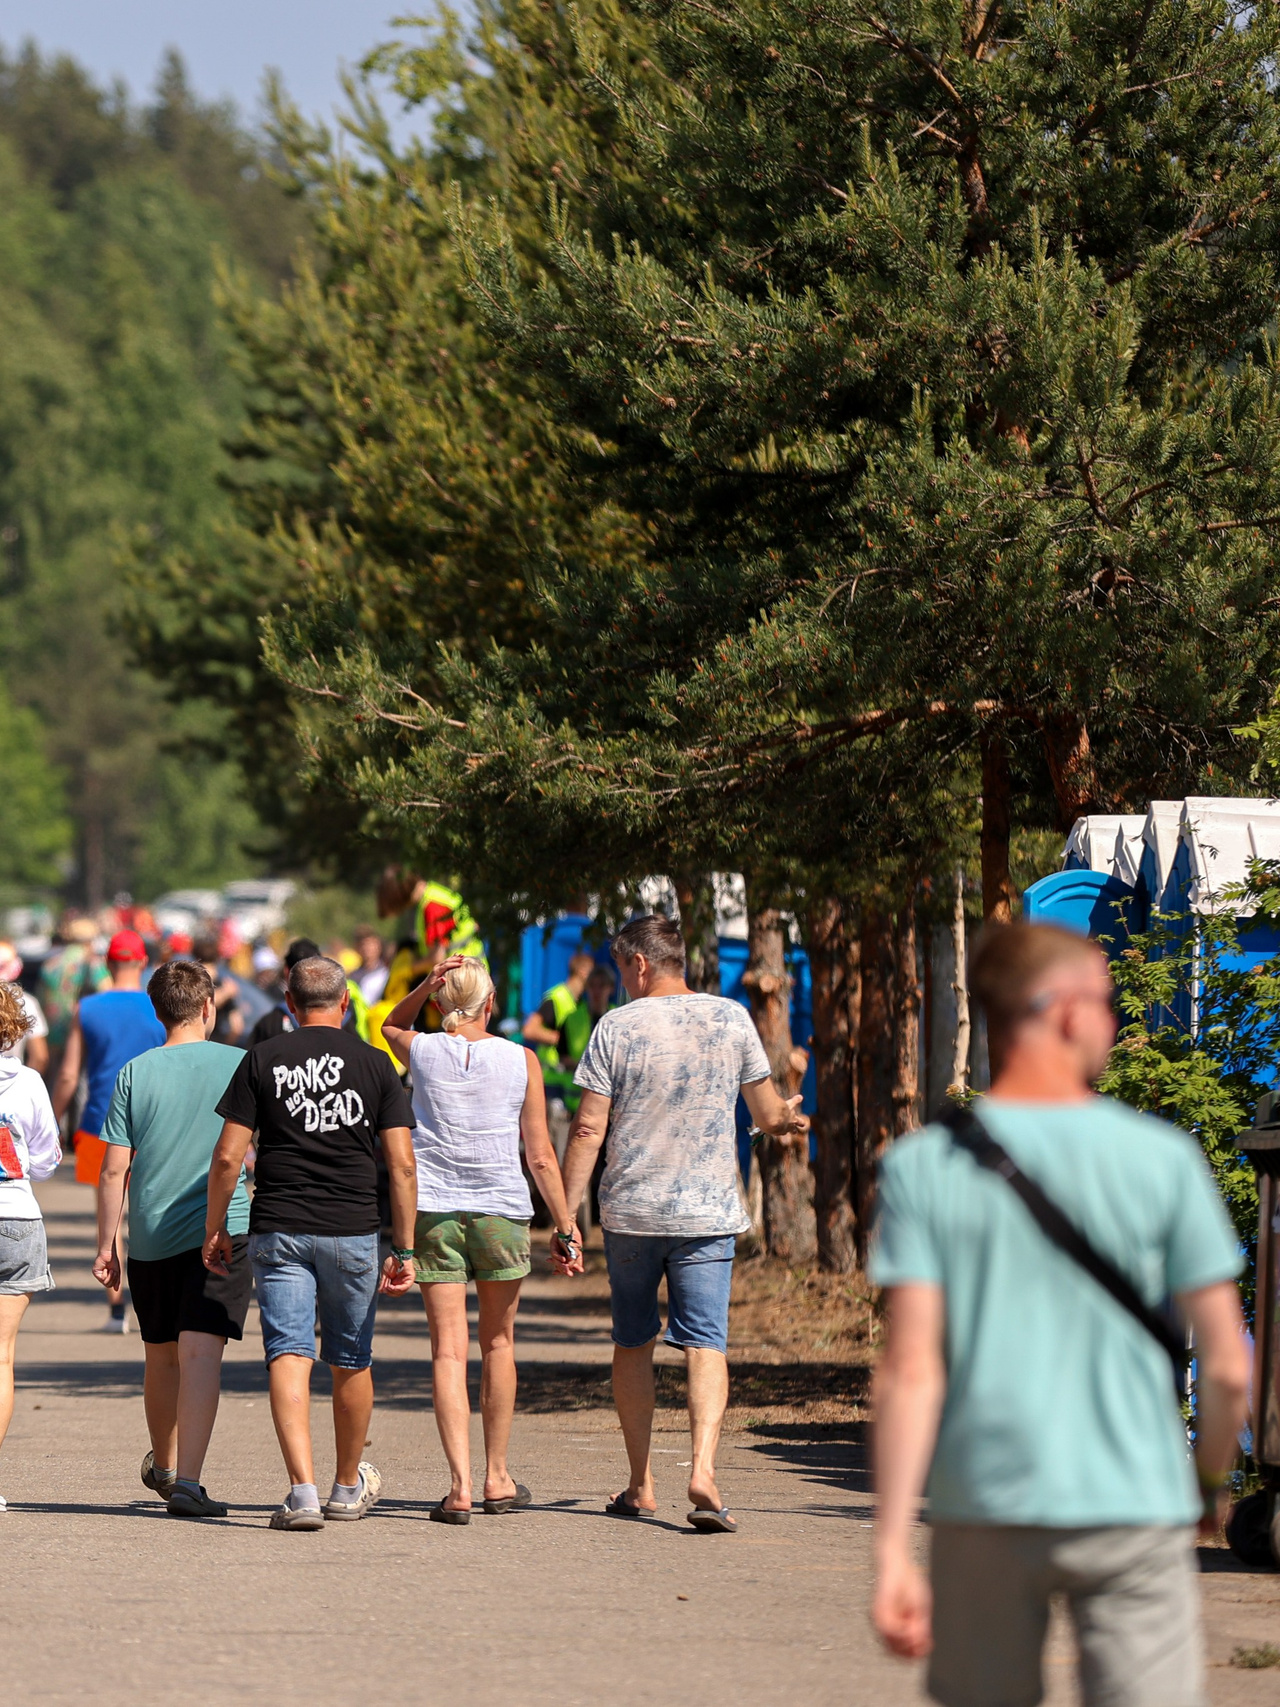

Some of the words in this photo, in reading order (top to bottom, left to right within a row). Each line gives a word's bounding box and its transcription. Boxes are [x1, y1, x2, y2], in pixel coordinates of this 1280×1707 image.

[273, 1053, 345, 1098] PUNK'S
[285, 1087, 306, 1112] NOT
[293, 1089, 370, 1132] DEAD.
